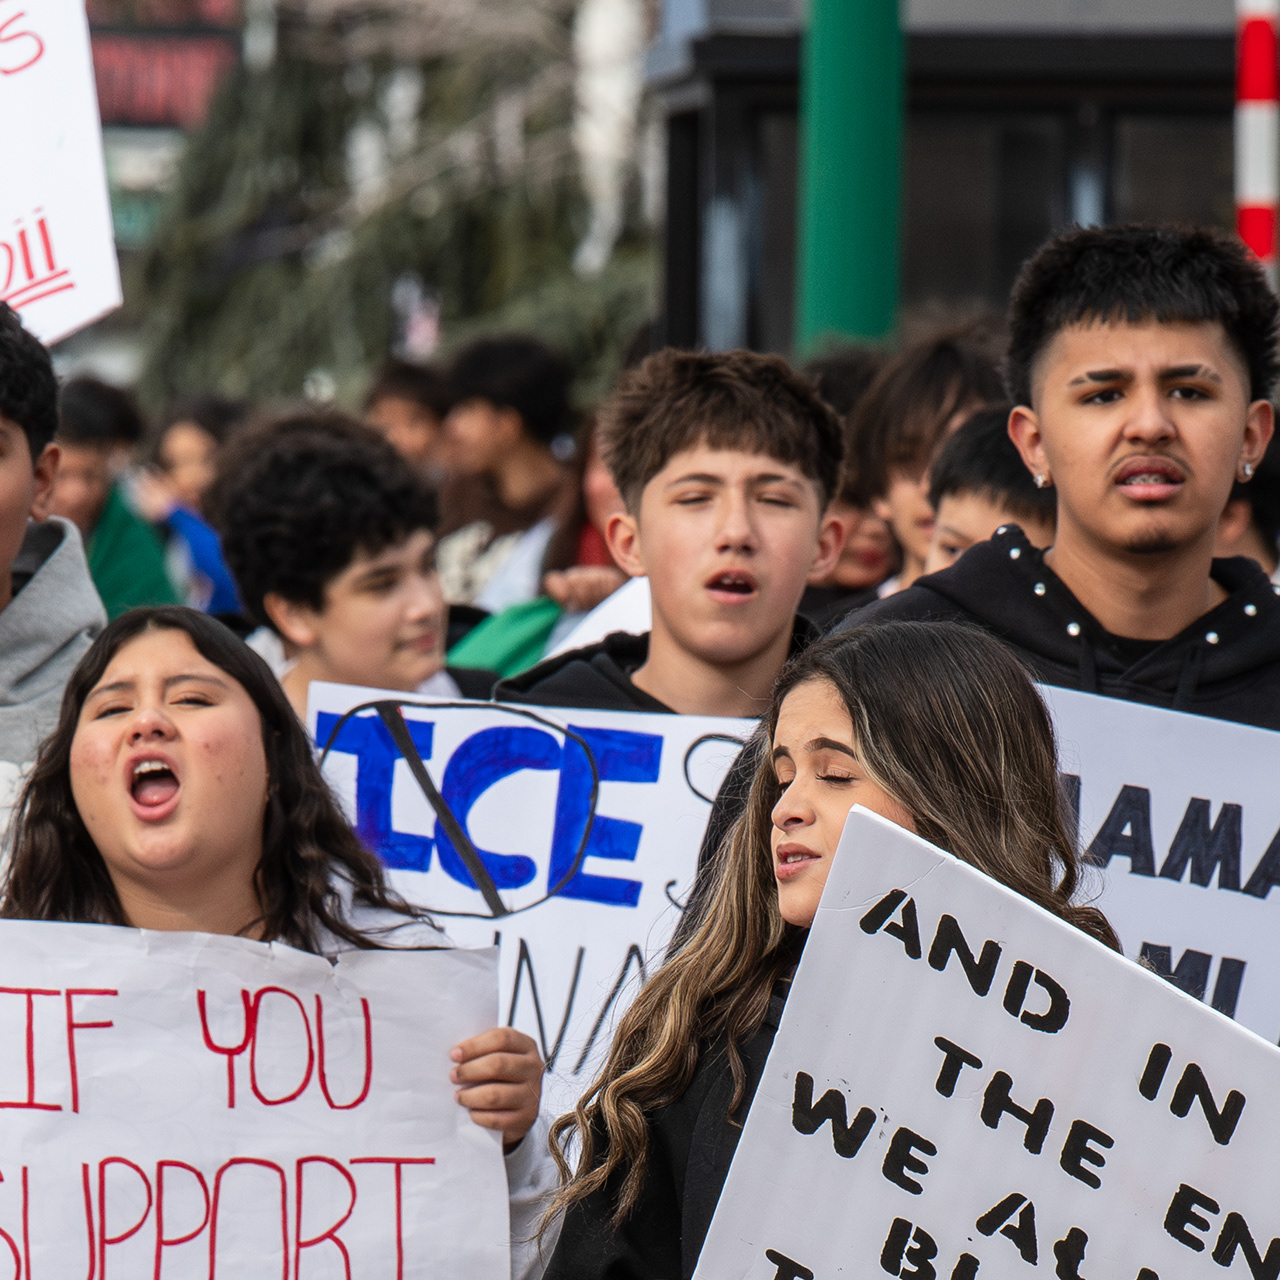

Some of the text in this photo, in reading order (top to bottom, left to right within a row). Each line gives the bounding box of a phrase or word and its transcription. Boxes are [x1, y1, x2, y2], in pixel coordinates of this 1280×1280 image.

[315, 710, 664, 909] ICE
[197, 985, 374, 1110] YOU
[858, 887, 1247, 1146] AND IN
[791, 1070, 937, 1196] WE
[932, 1035, 1115, 1190] THE
